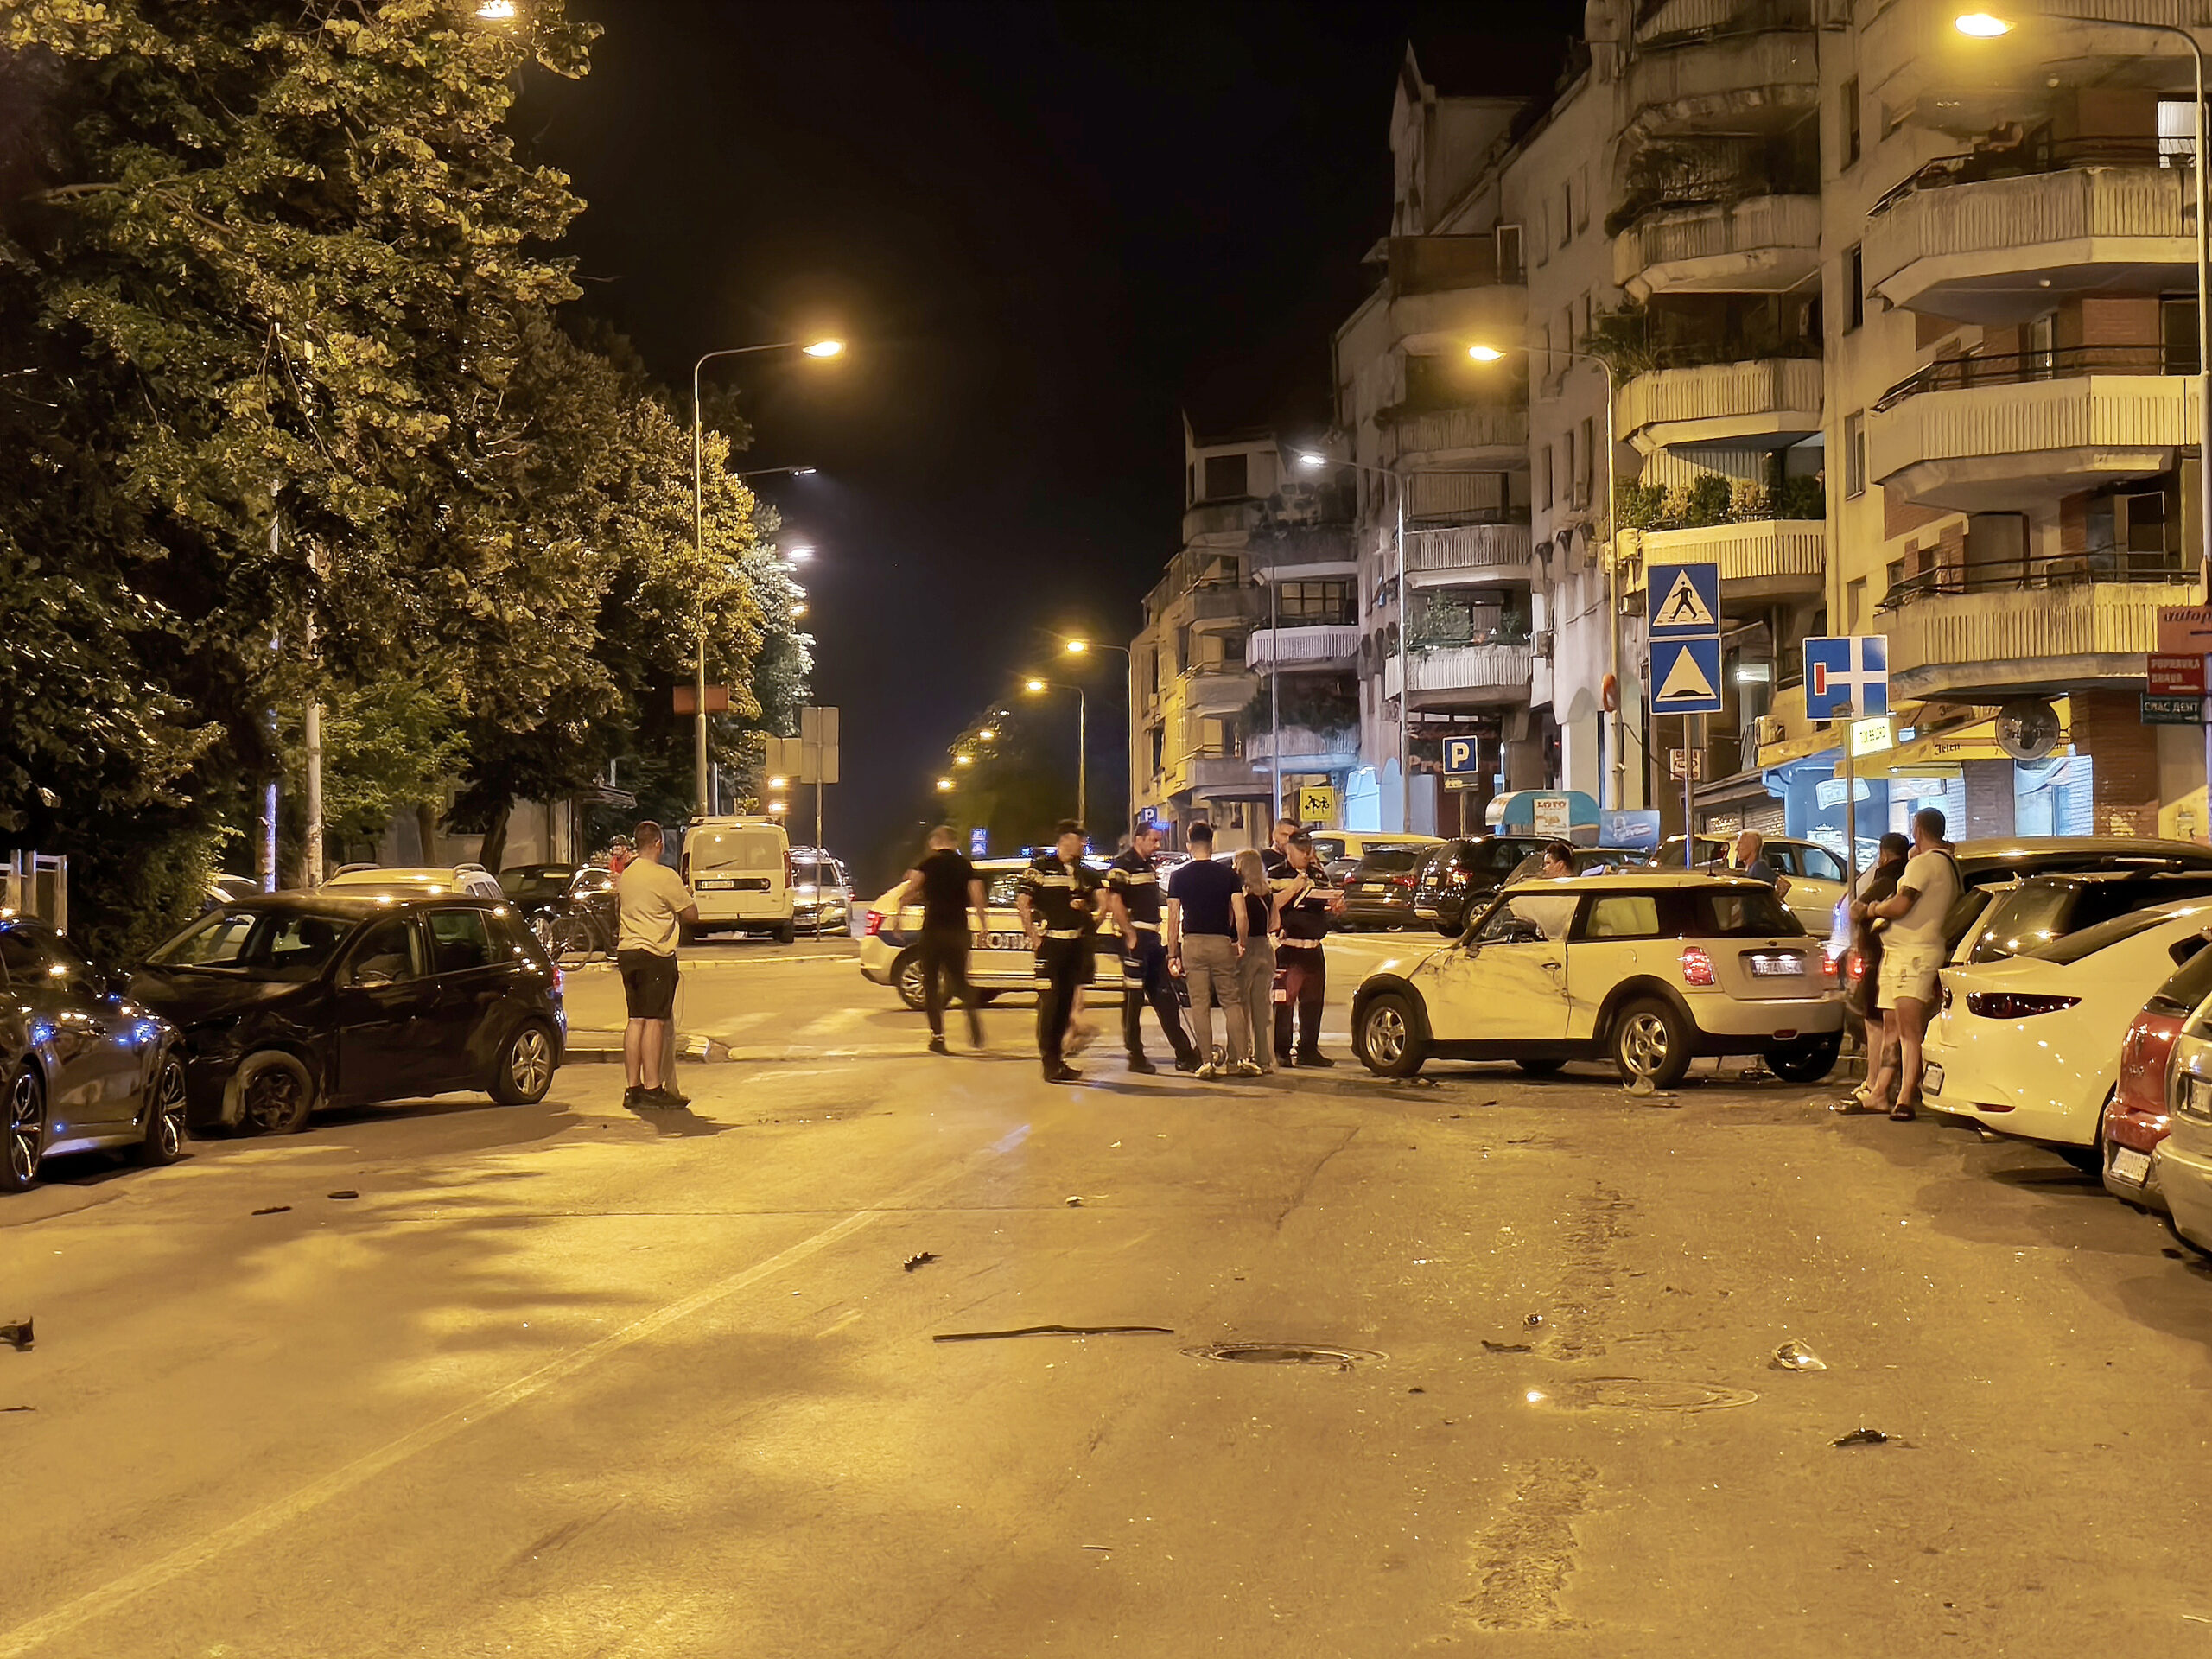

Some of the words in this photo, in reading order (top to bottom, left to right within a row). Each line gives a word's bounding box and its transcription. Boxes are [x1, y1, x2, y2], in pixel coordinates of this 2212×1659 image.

[1451, 742, 1470, 769] P
[1934, 743, 1961, 755] Jelen
[1144, 808, 1154, 822] P
